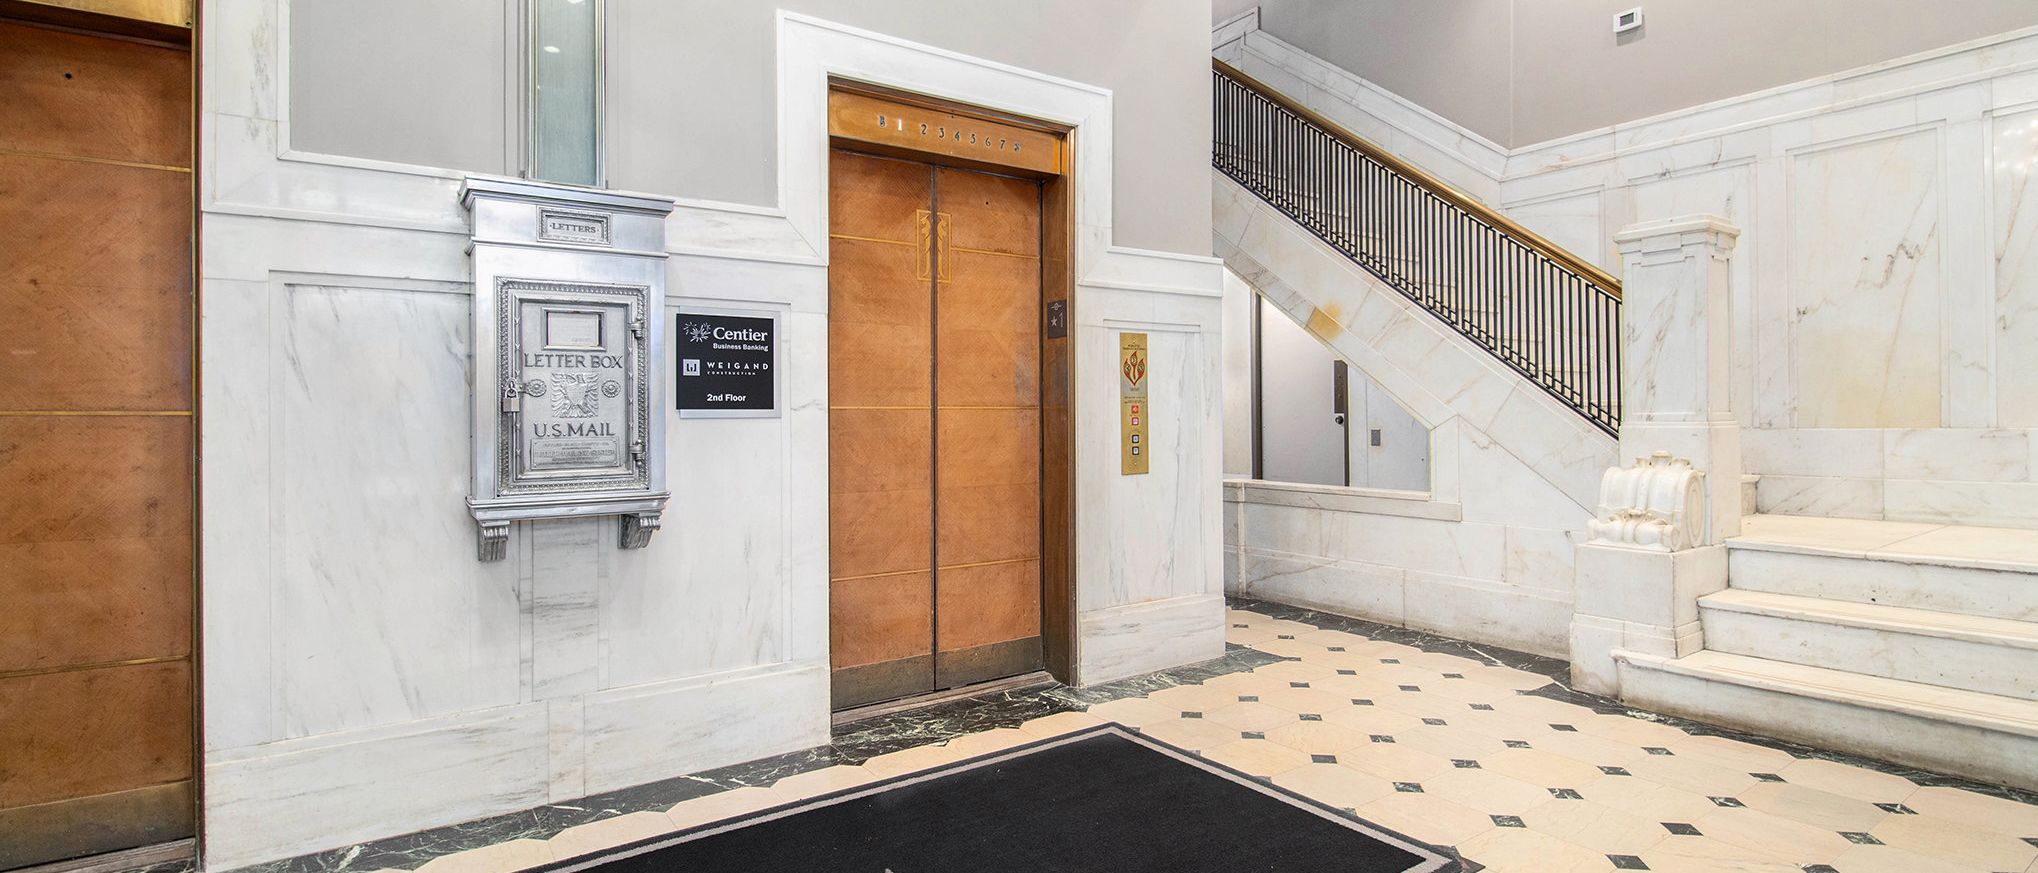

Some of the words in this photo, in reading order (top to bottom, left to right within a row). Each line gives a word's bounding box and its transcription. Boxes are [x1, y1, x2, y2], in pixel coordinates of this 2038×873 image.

[898, 119, 903, 131] 1
[921, 124, 927, 135] 2
[939, 127, 945, 139] 3
[954, 131, 960, 141] 4
[970, 133, 976, 144] 5
[985, 136, 991, 147] 6
[1000, 139, 1006, 150] 7
[552, 222, 596, 234] LETTERS
[713, 326, 768, 341] Centier
[712, 342, 742, 350] Business
[742, 343, 769, 352] Banking
[523, 352, 587, 368] LETTER
[590, 354, 623, 369] BOX
[707, 361, 769, 370] WEIGAND
[706, 393, 723, 402] 2nd
[725, 393, 747, 402] Floor
